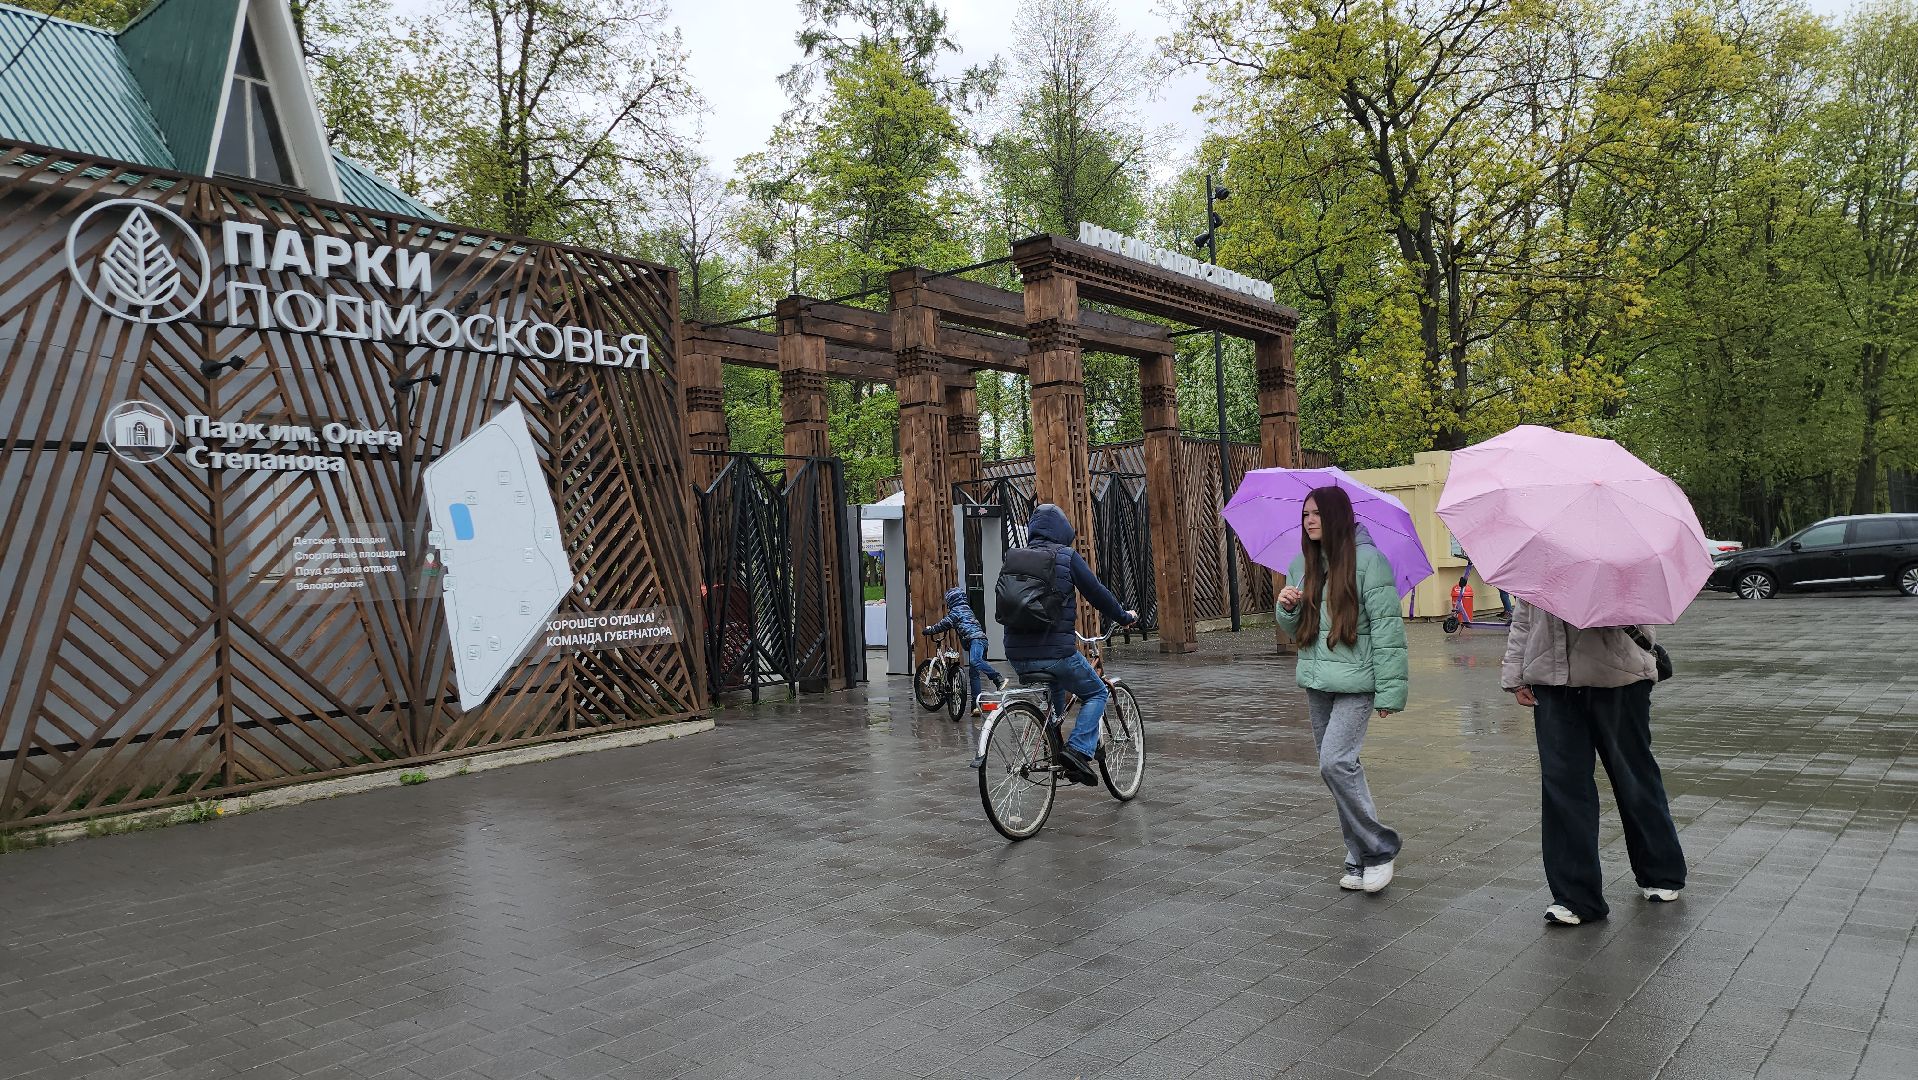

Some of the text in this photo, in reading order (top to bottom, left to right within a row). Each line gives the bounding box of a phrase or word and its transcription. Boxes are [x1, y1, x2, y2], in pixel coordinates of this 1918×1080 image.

[223, 220, 432, 293] ПАРКИ
[226, 281, 650, 370] ПОДМОСКОВЬЯ
[185, 414, 403, 447] Парк им. Олега
[185, 445, 346, 472] Степанова
[293, 536, 387, 547] Детские площадки
[294, 549, 406, 561] Спортивные площадки
[295, 566, 322, 577] Пруд
[332, 564, 362, 574] зоной
[363, 564, 398, 574] отдыха
[296, 580, 364, 591] Велодорожка
[546, 612, 655, 632] ХОРОШЕГО ОТДЫХА!
[546, 626, 672, 647] КОМАНДА ГУБЕРНАТОРА
